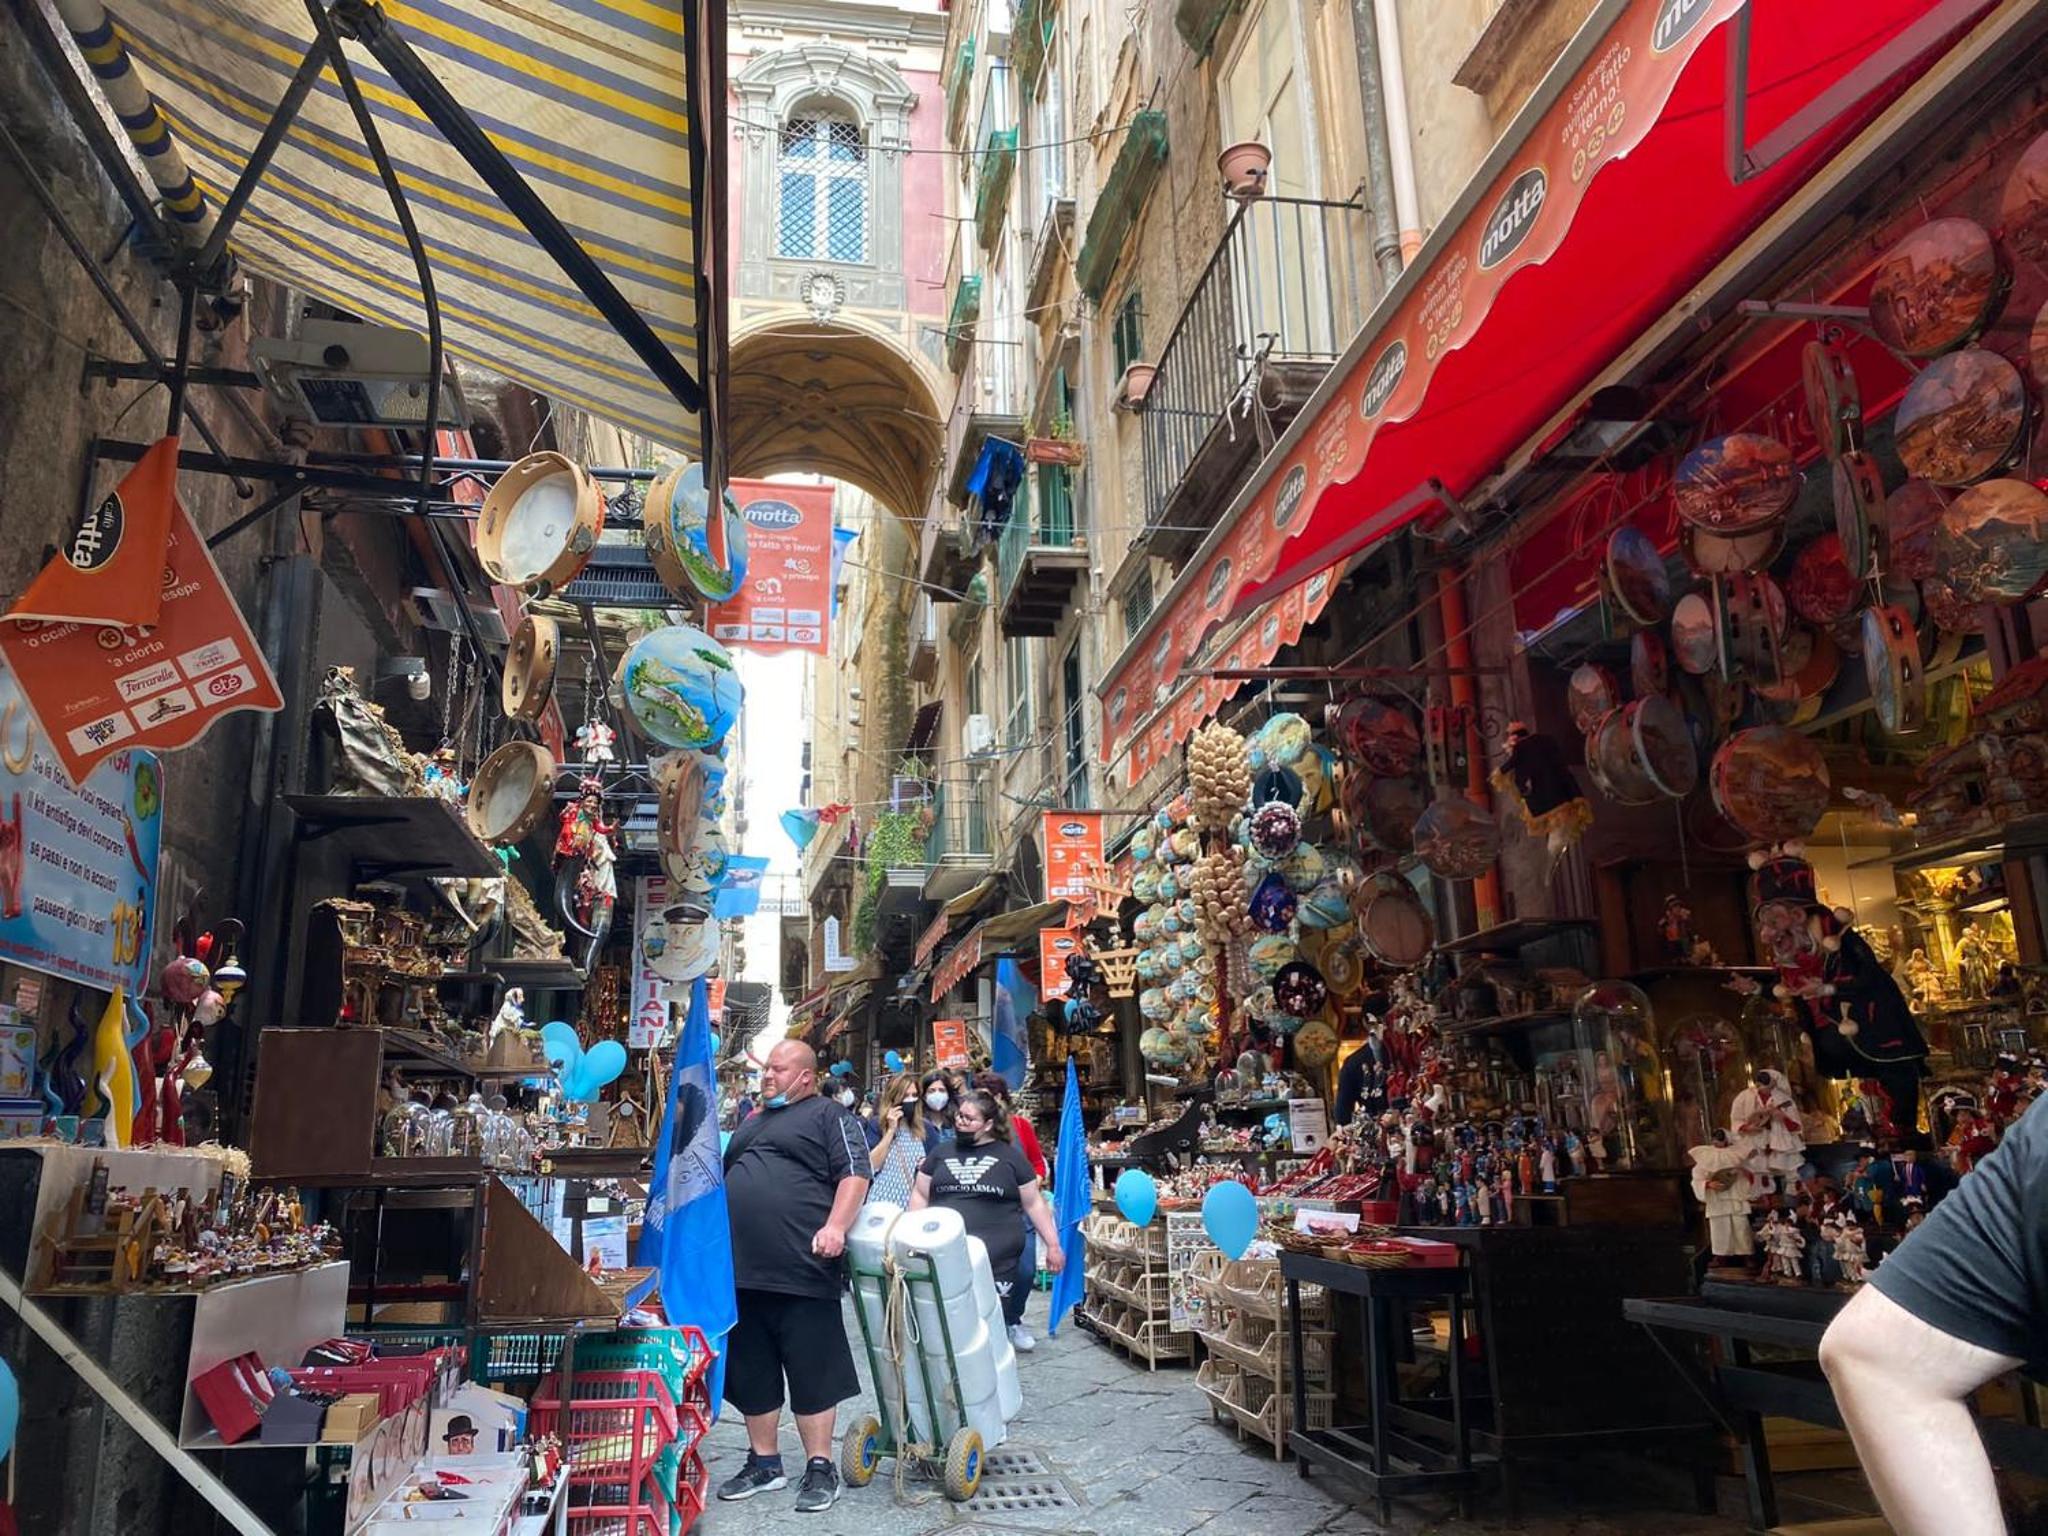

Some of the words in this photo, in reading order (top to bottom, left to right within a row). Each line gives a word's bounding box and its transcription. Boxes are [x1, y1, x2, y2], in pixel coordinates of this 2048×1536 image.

[1482, 178, 1544, 265] motta
[1363, 350, 1406, 417] motta
[745, 509, 802, 523] motta
